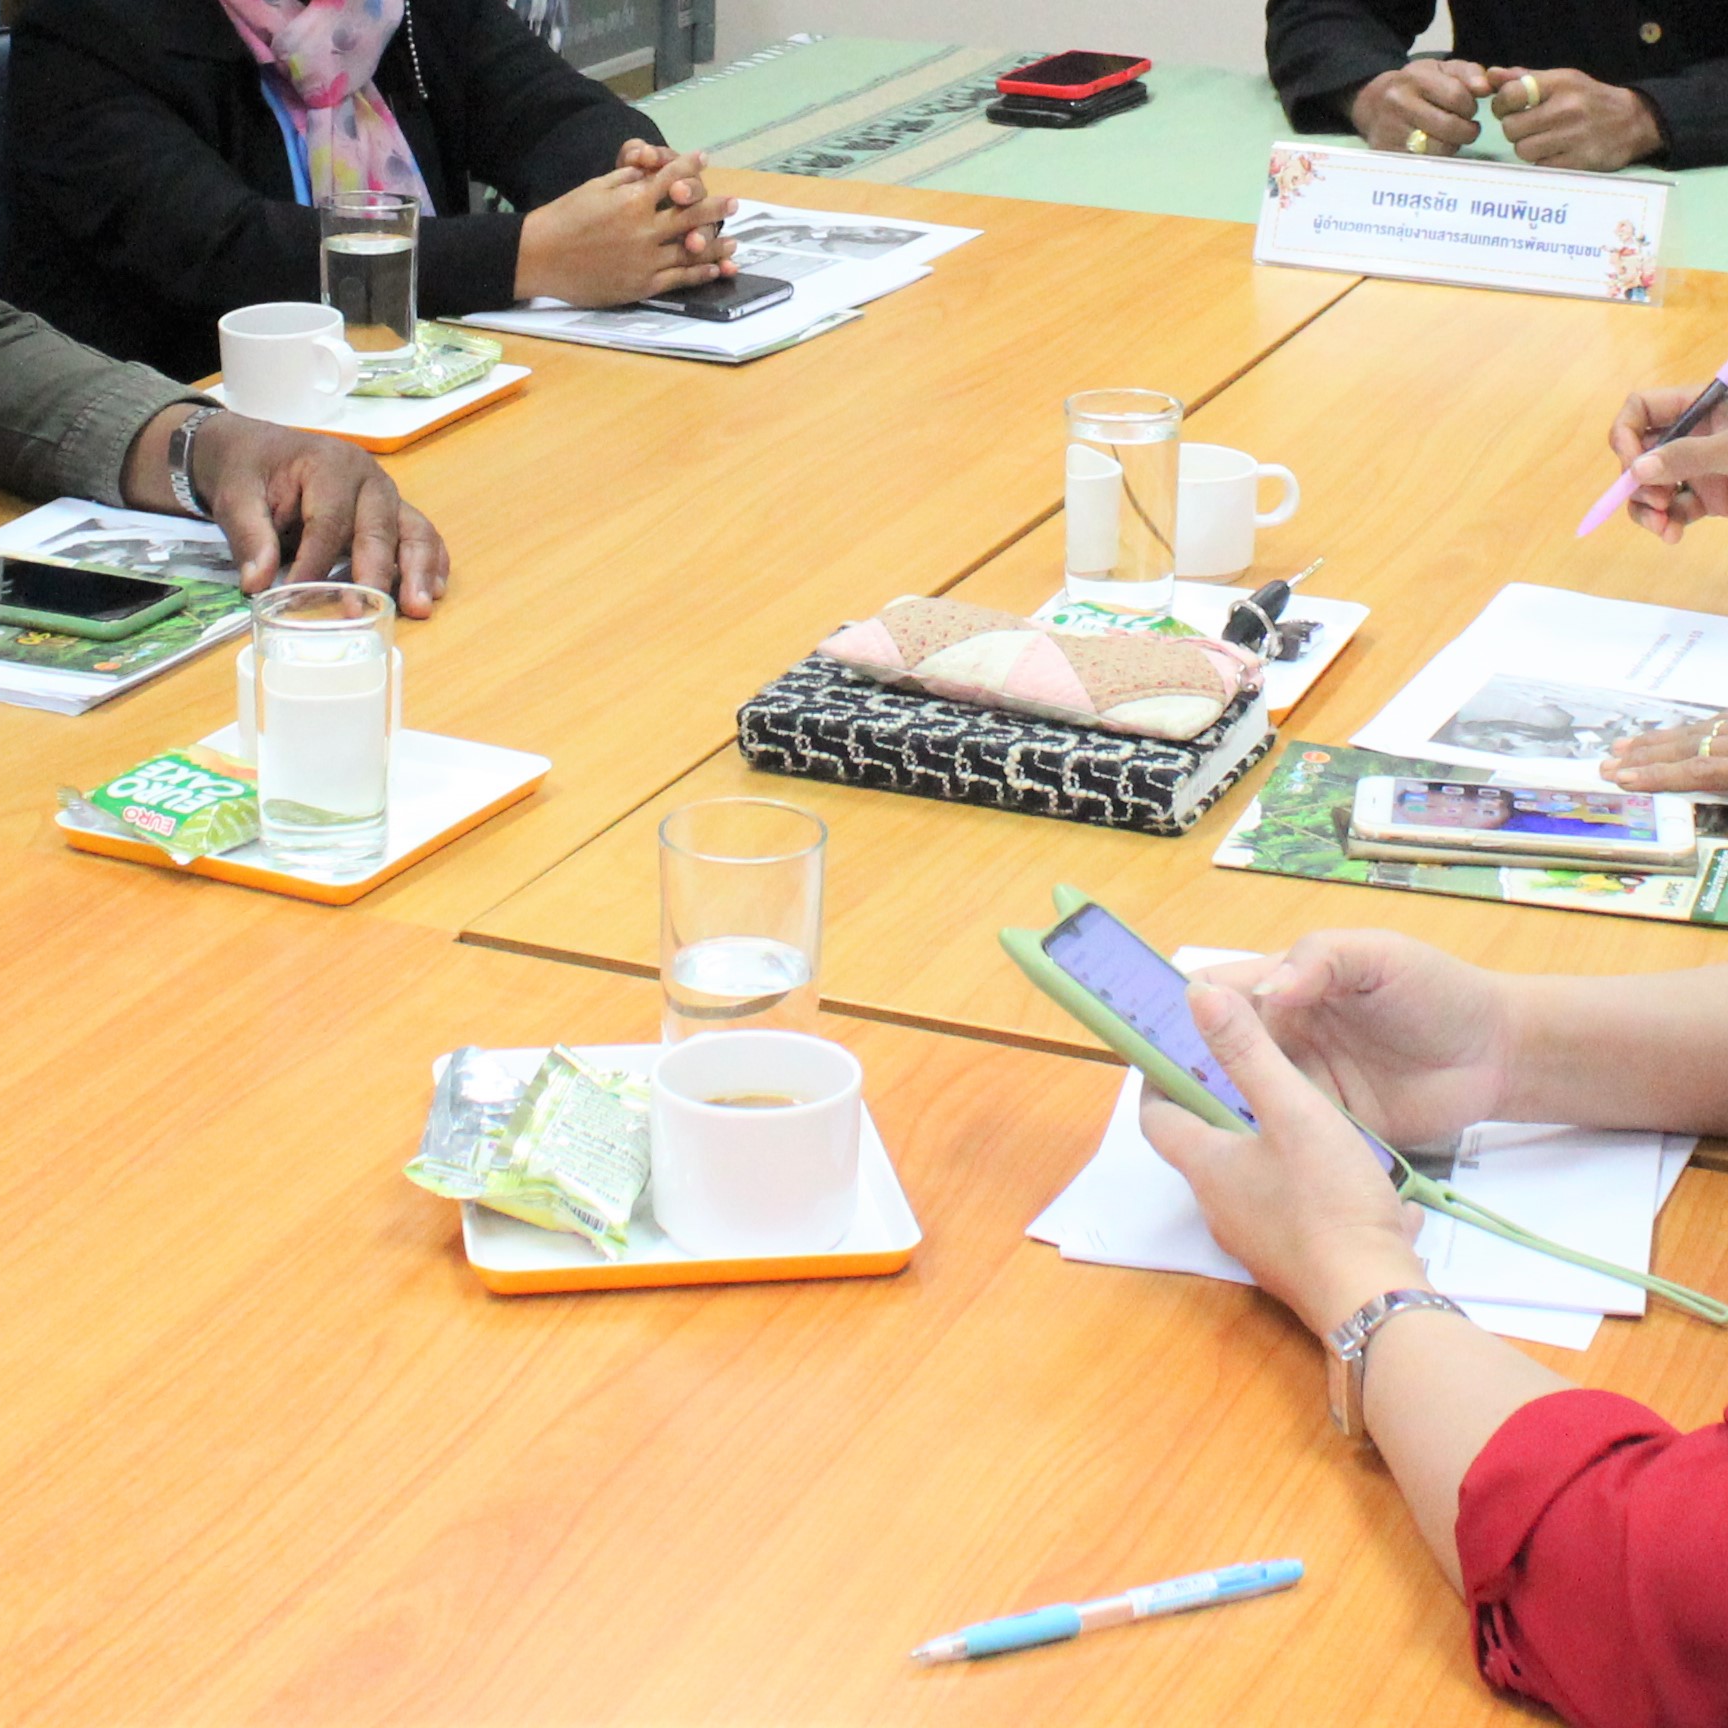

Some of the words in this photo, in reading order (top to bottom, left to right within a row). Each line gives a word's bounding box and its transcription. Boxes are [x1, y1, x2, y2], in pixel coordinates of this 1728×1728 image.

[1371, 188, 1458, 217] นายสุรชัย
[105, 775, 219, 815] EURO
[135, 759, 246, 798] CAKE
[122, 804, 177, 838] EURO
